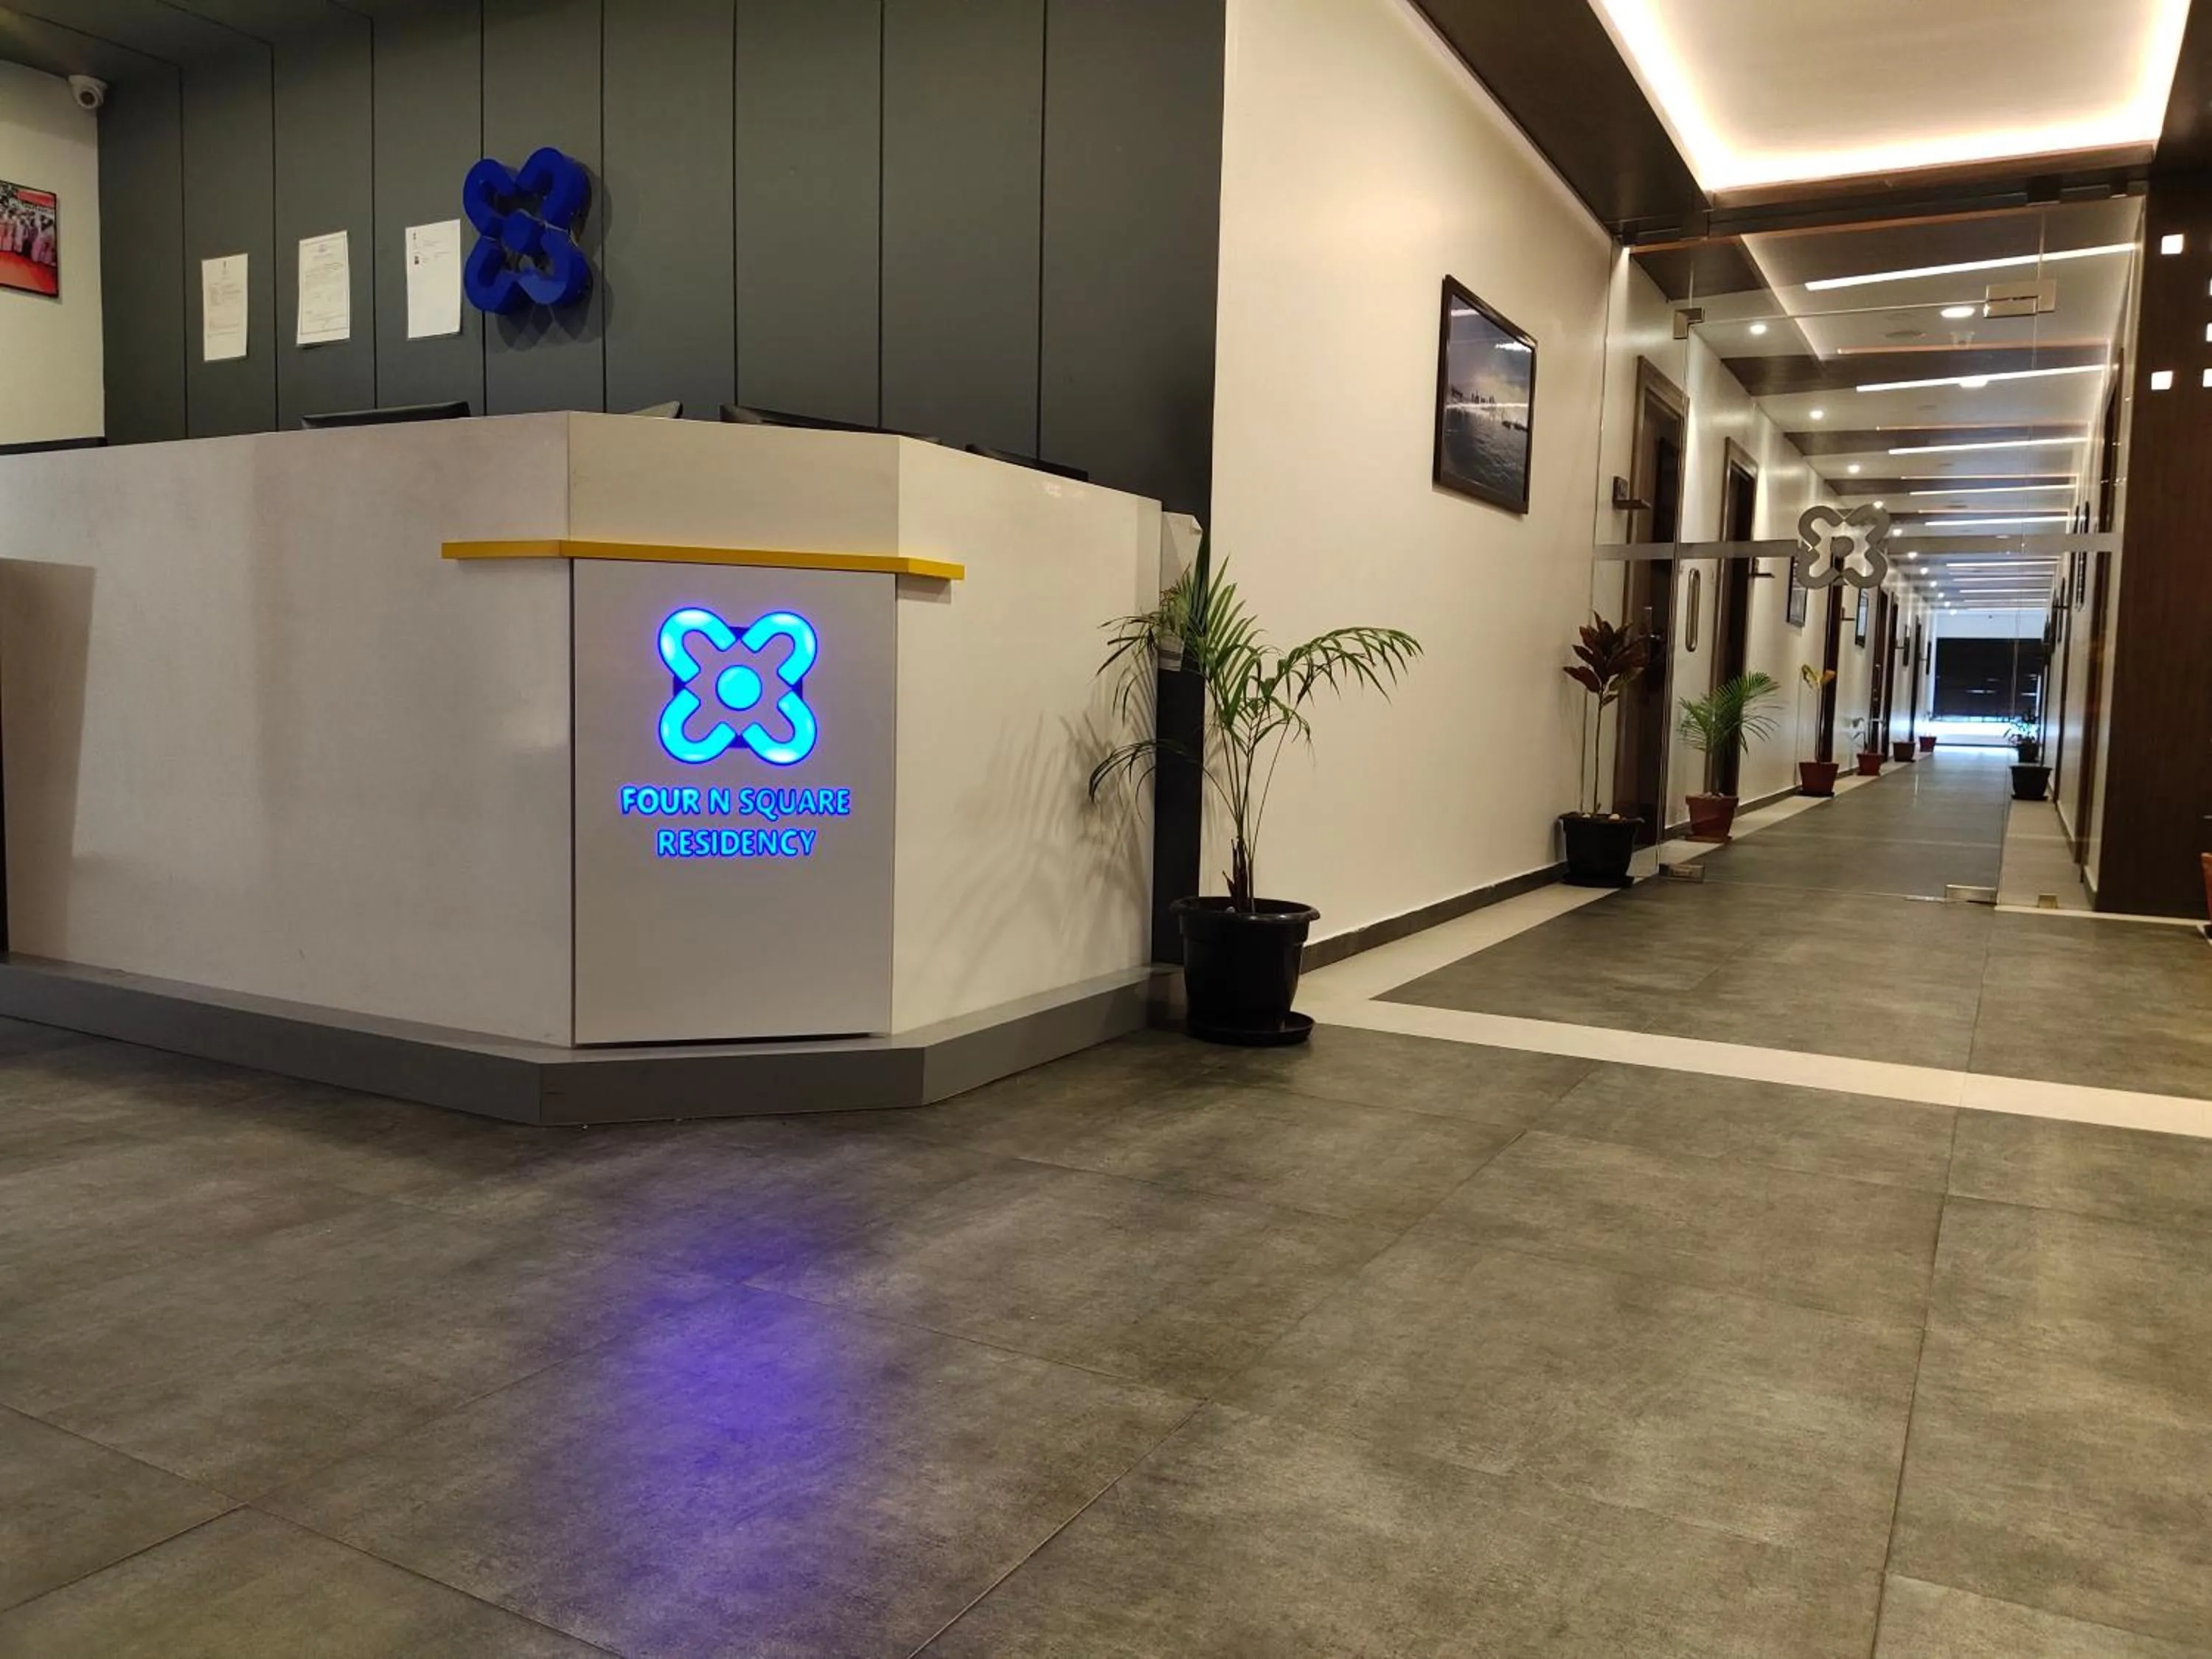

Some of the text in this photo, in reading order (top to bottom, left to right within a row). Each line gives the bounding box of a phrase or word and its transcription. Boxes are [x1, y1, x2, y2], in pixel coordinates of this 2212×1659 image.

[621, 786, 850, 822] FOUR N SQUARE
[656, 829, 816, 856] RESIDENCY
